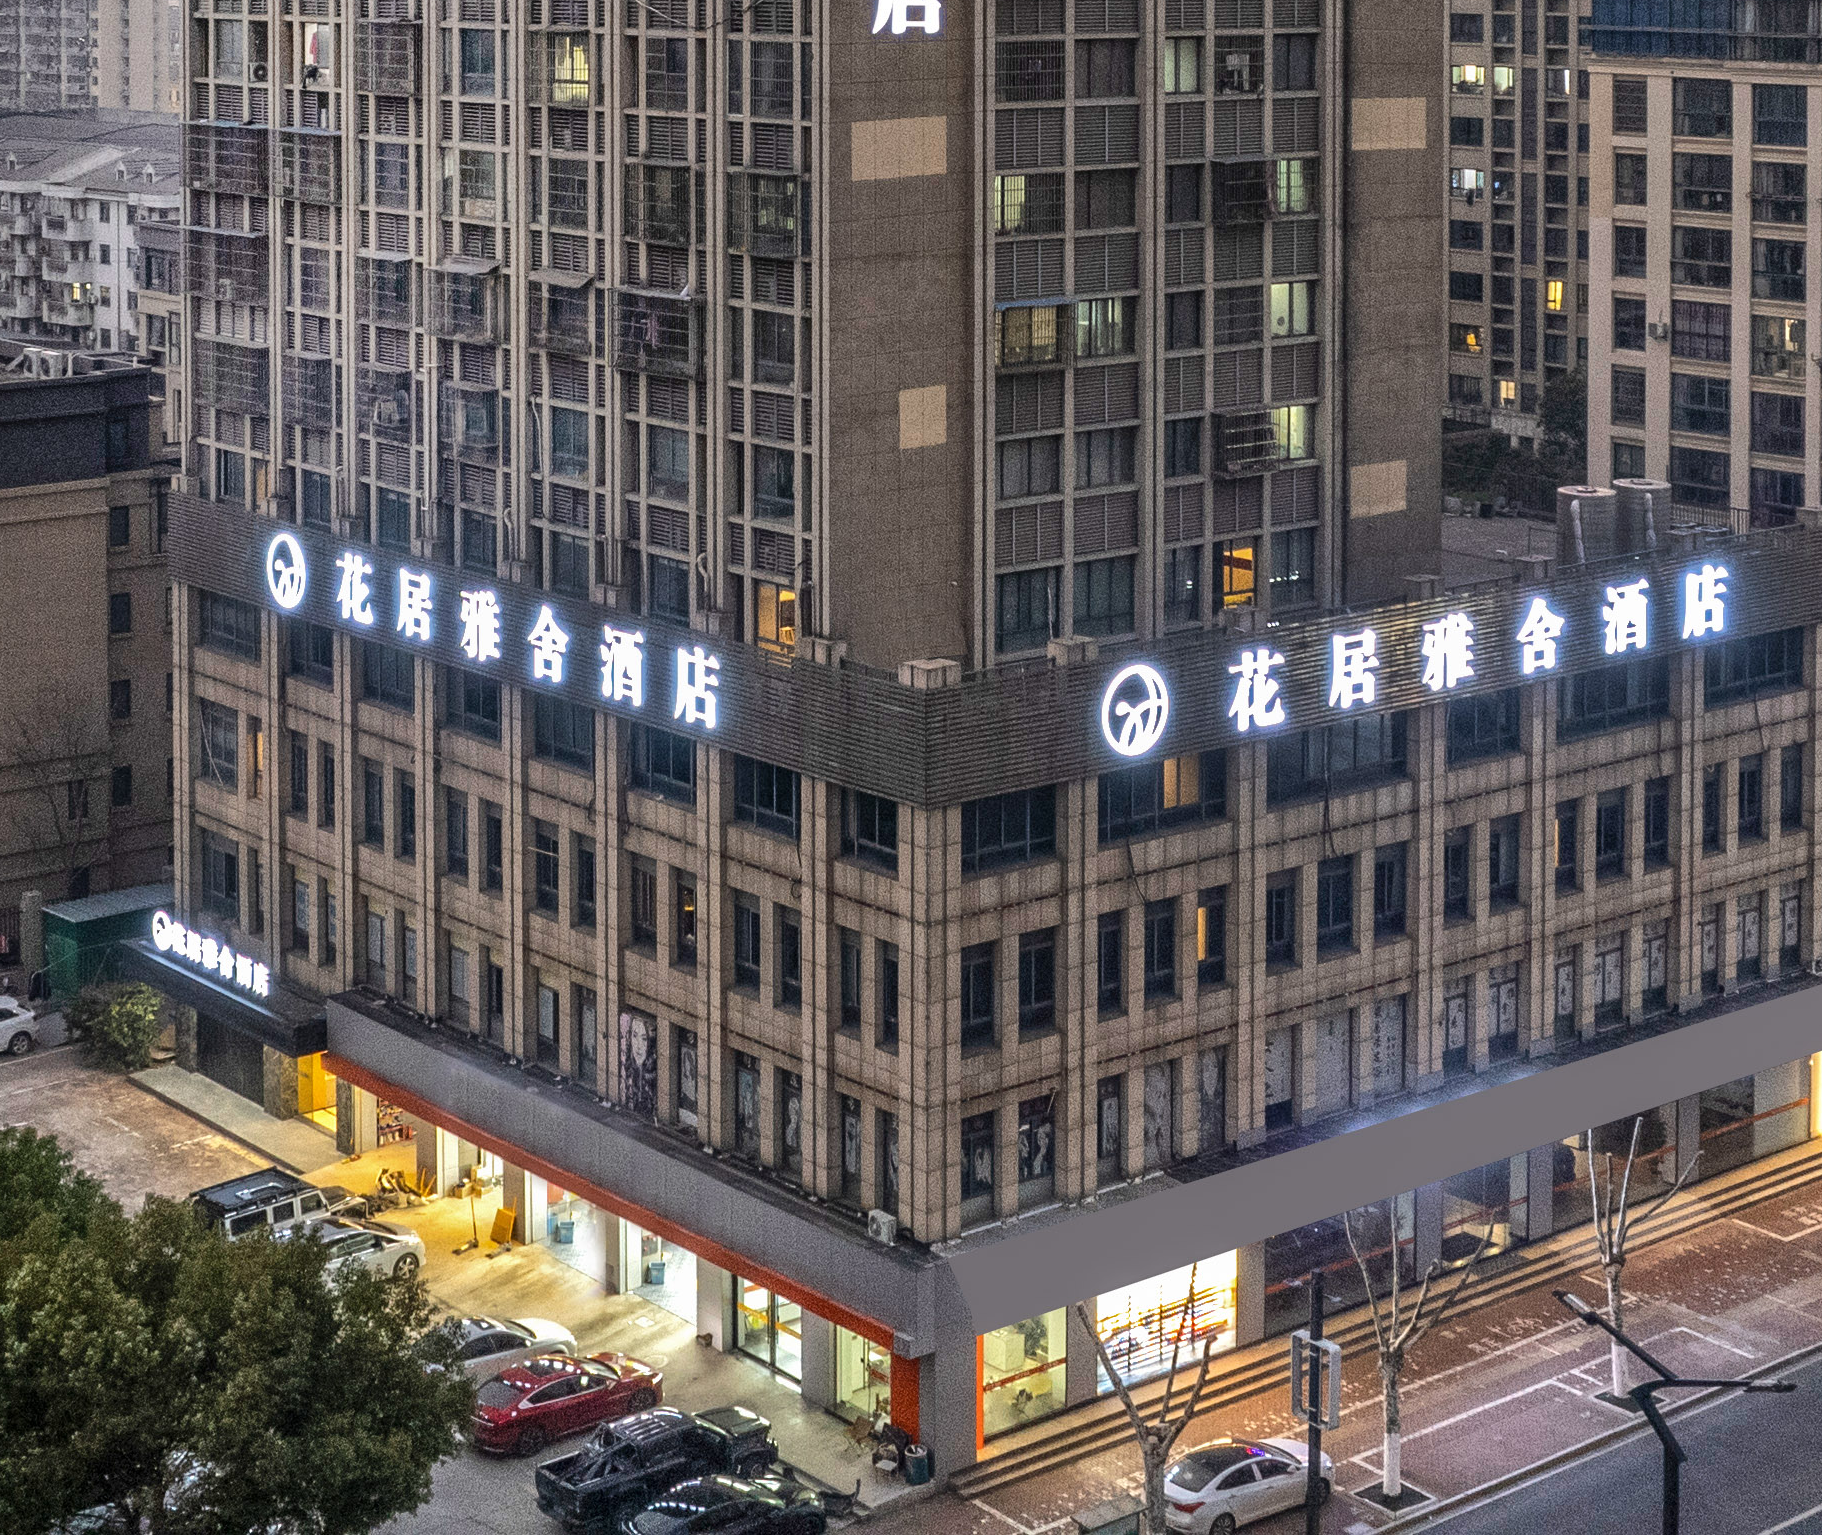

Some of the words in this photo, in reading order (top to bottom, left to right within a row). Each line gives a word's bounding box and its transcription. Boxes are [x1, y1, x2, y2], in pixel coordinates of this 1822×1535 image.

[335, 552, 721, 729] 花居雅舍酒店
[1228, 564, 1729, 732] 花居雅舍酒店
